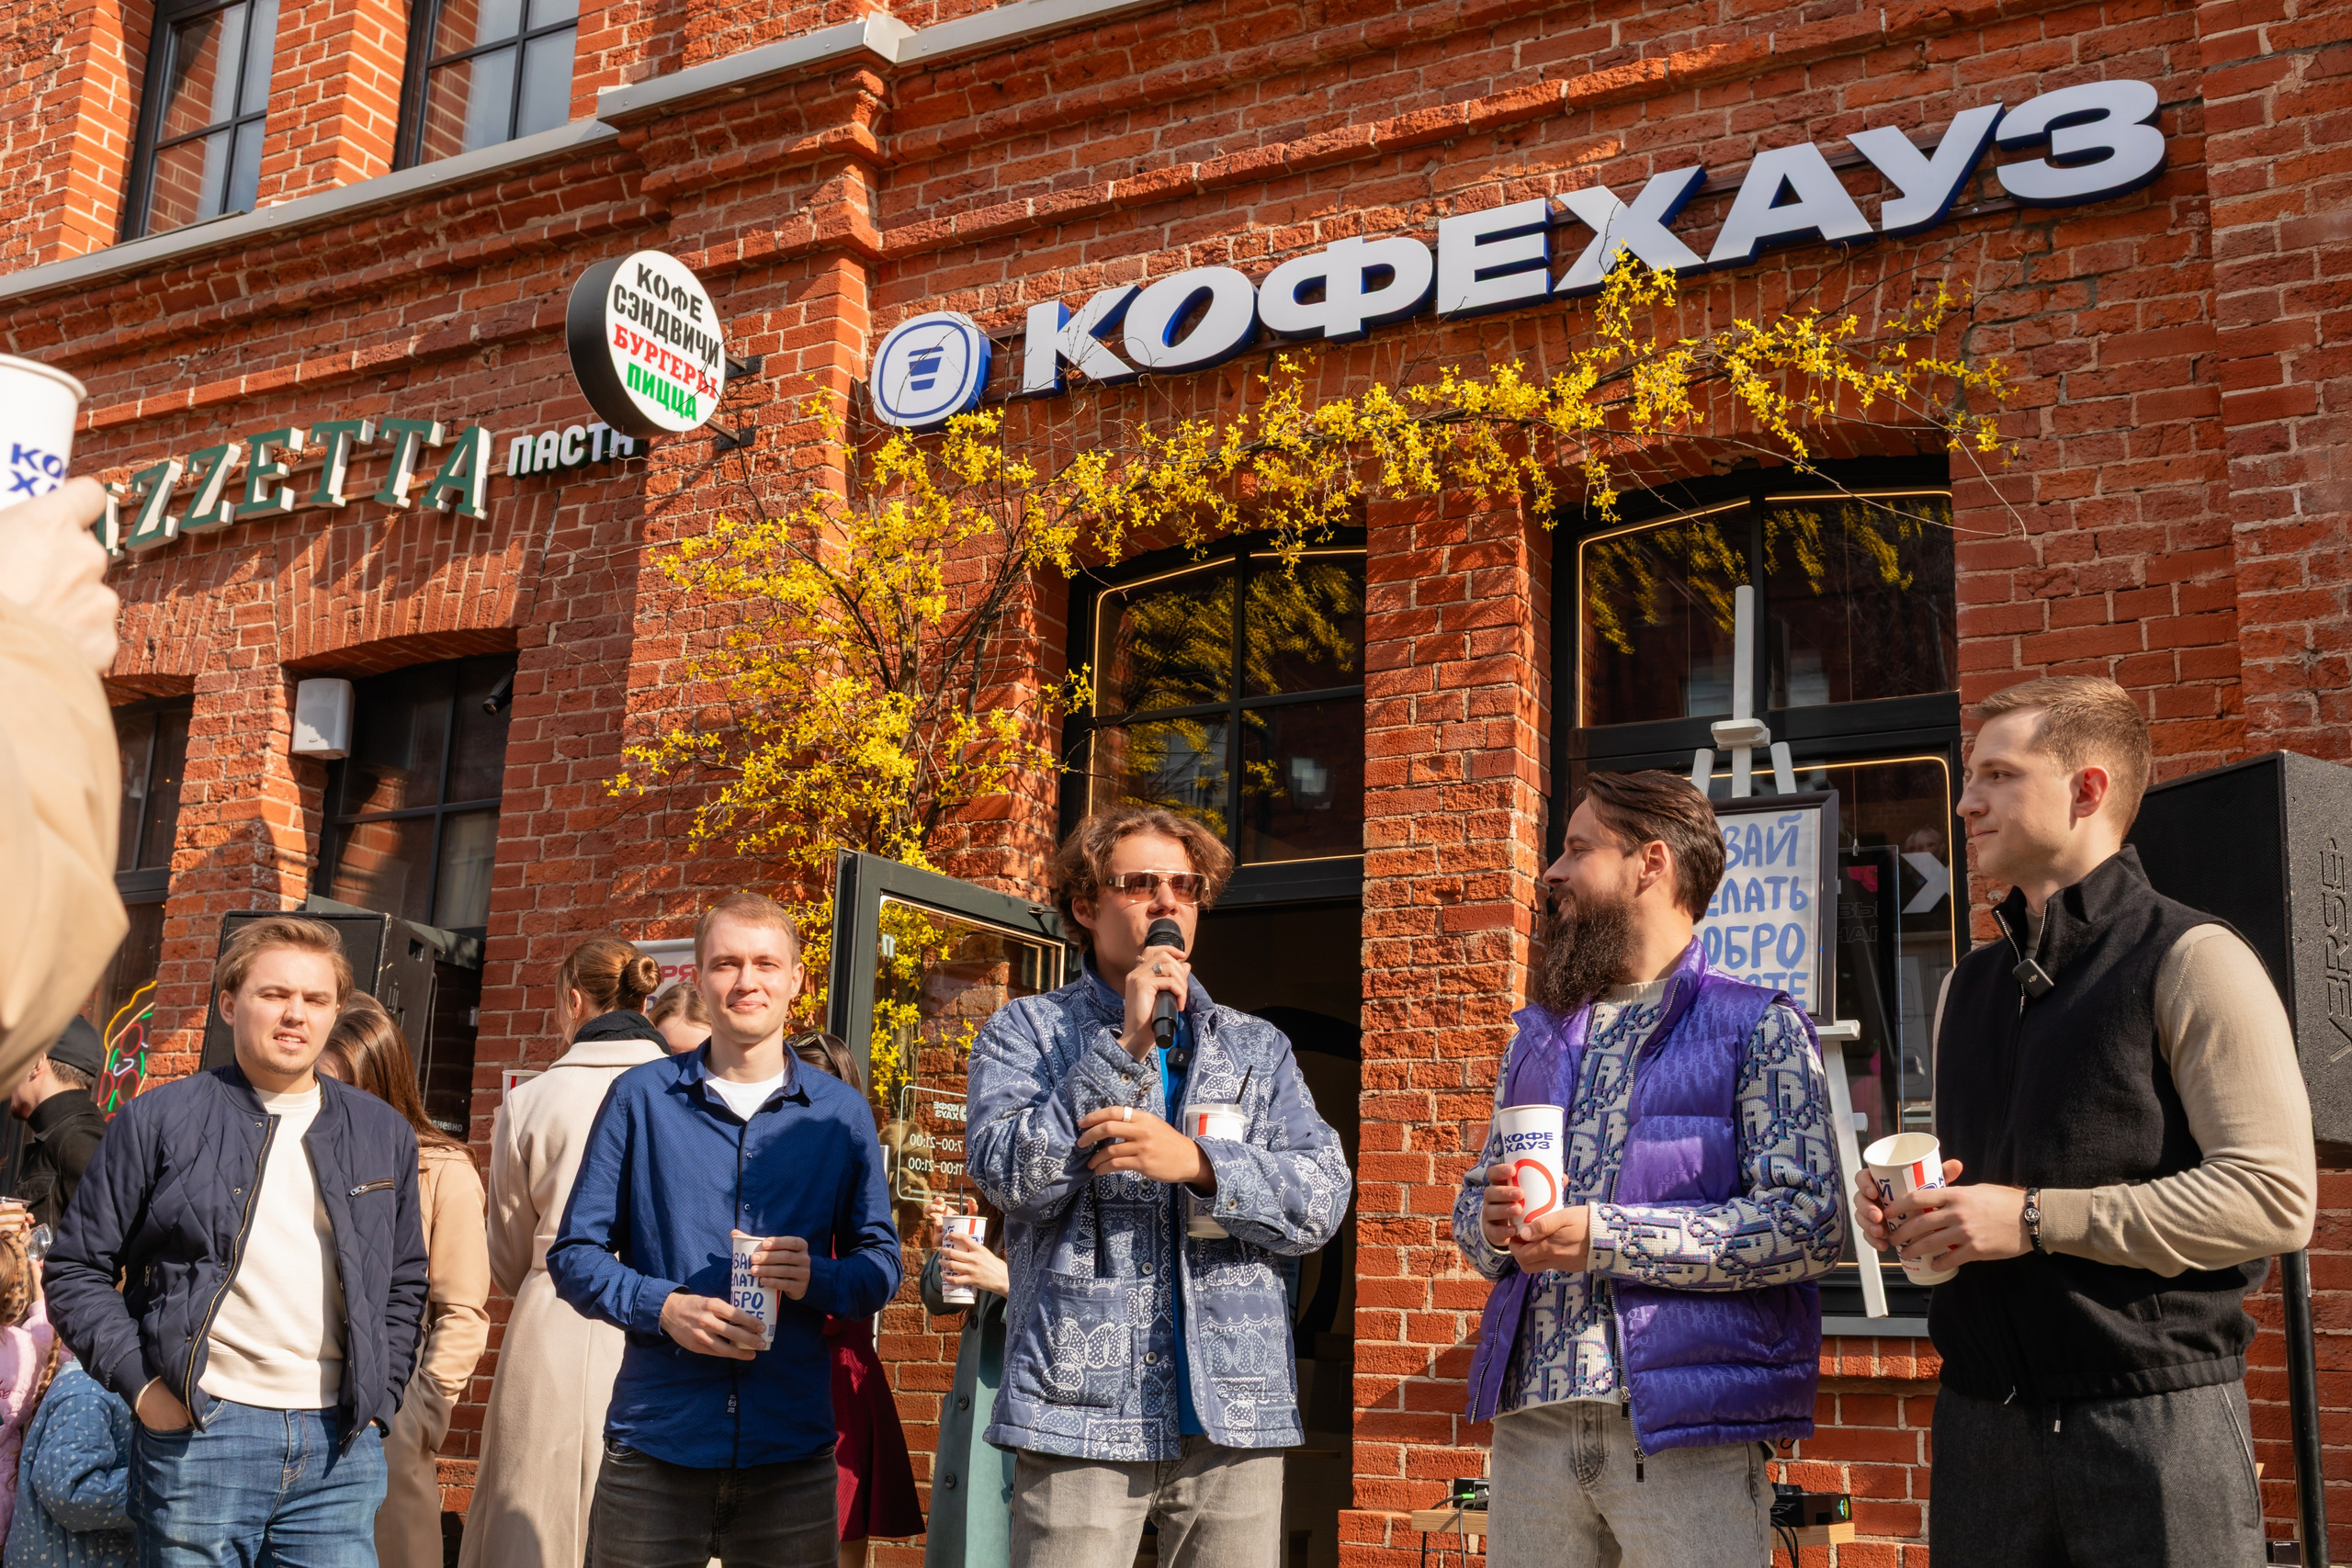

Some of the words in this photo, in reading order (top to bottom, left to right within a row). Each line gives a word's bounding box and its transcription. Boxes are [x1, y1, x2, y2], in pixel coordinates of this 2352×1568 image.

[1022, 79, 2166, 396] КОФЕХАУЗ
[637, 263, 703, 322] КОФЕ
[613, 284, 719, 368] СЭНДВИЧИ
[614, 323, 718, 400] БУРГЕРЫ
[627, 362, 697, 422] ПИЦЦА
[1504, 1132, 1554, 1145] КОФЕ
[1505, 1141, 1551, 1154] ХАУЗ
